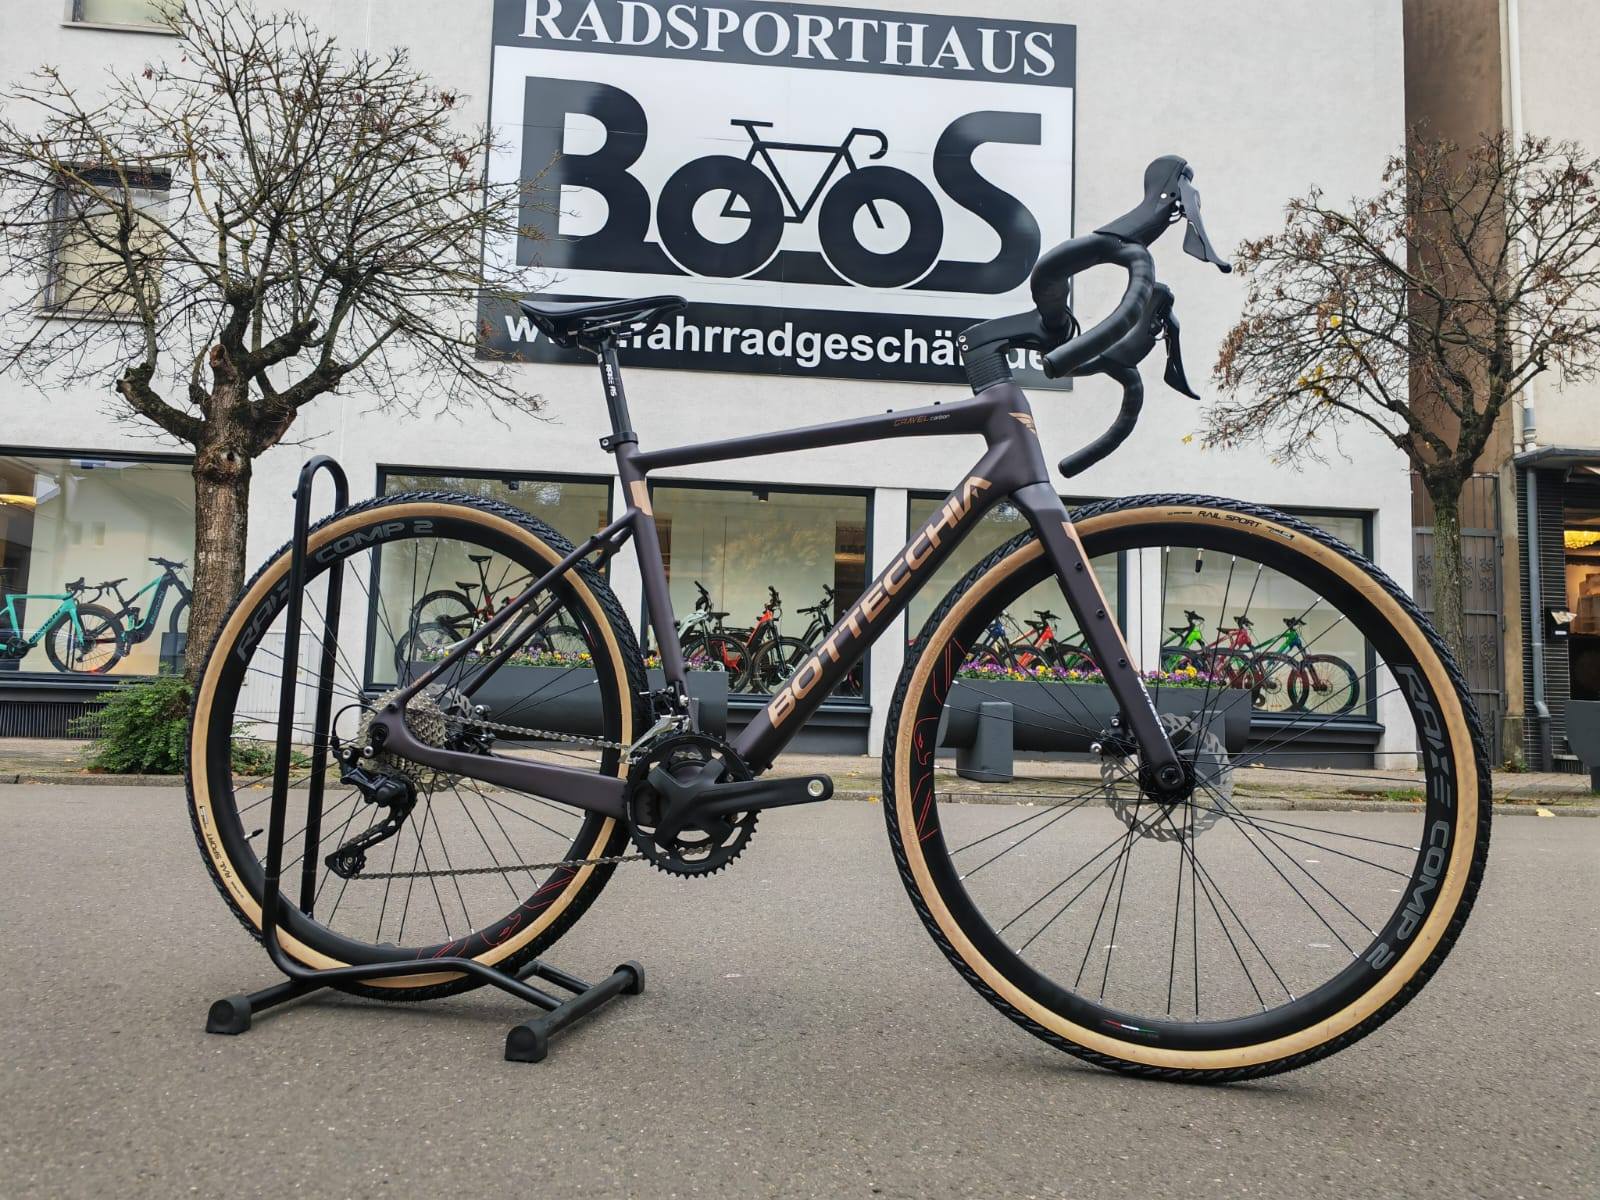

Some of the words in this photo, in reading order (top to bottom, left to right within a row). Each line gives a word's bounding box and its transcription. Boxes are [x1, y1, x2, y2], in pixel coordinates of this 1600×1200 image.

[518, 0, 1056, 77] RADSPORTHAUS
[315, 522, 406, 564] COMP
[413, 520, 434, 534] 2
[1198, 510, 1221, 520] RAIL
[1225, 514, 1262, 528] SPORT
[767, 475, 993, 729] BOTTECCHIA
[1396, 819, 1450, 941] COMP
[1365, 942, 1396, 971] 2
